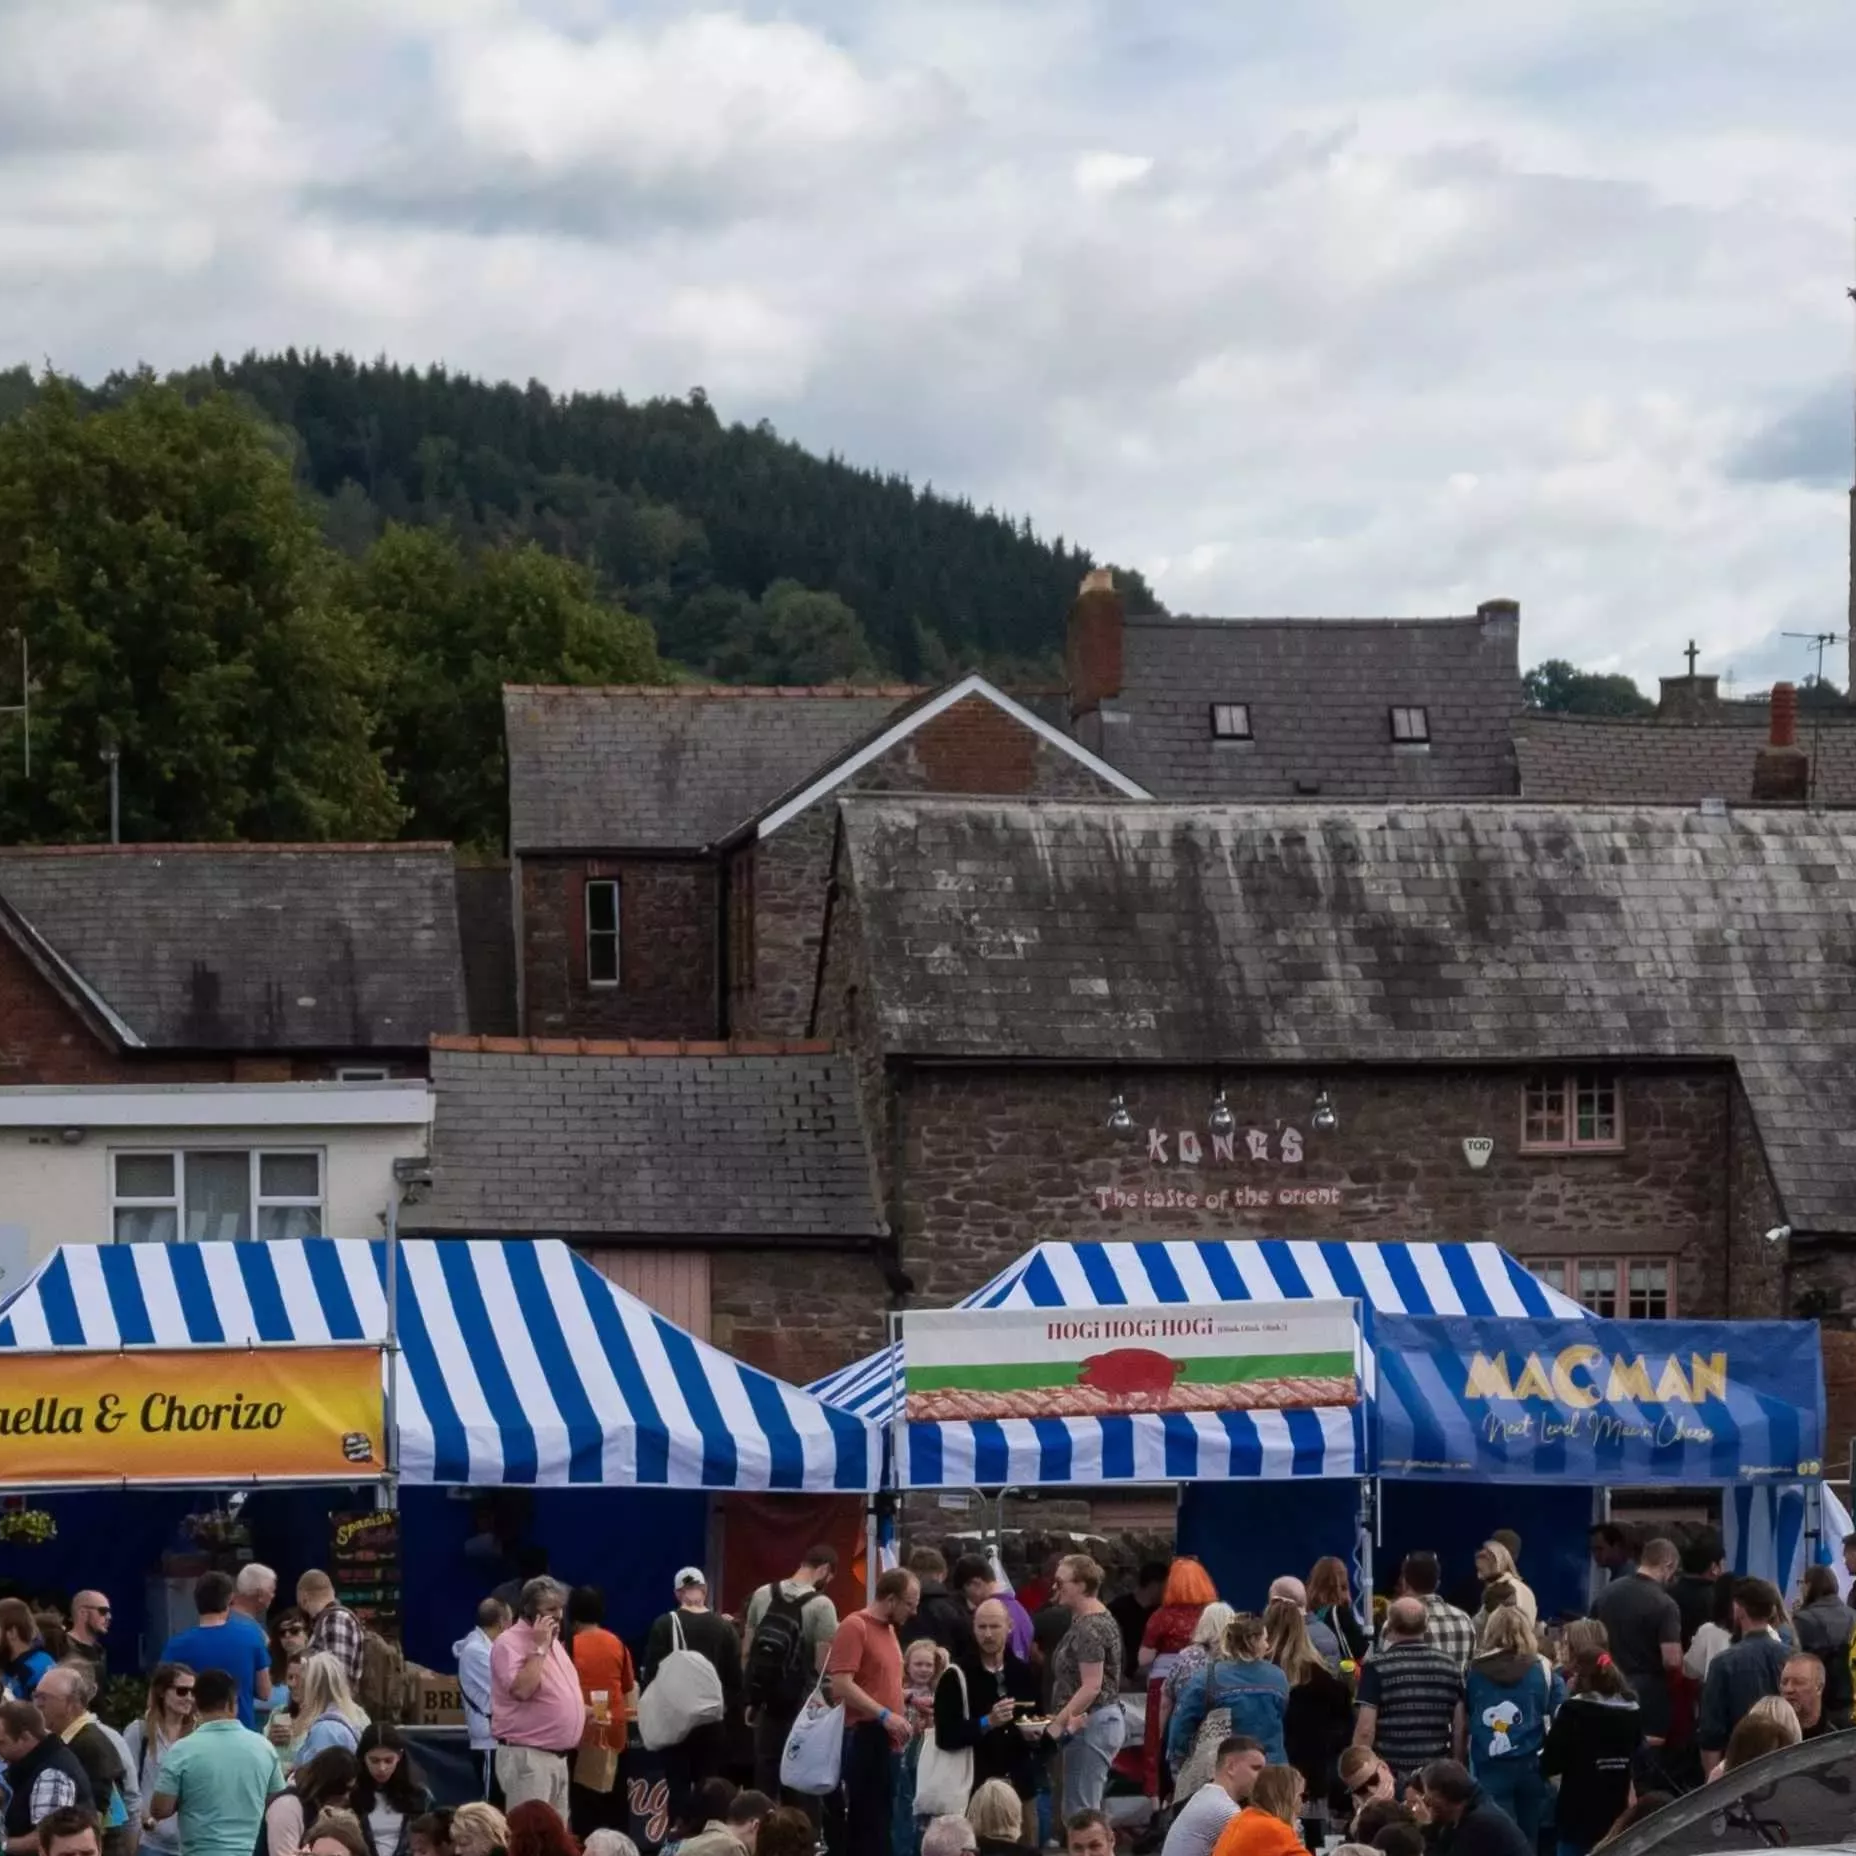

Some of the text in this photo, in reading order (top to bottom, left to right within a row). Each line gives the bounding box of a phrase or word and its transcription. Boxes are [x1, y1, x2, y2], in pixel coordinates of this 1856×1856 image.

[1096, 1185, 1341, 1210] The taste of the orient
[1465, 1344, 1727, 1409] MACMAN
[95, 1393, 127, 1432] &
[140, 1392, 287, 1433] Chorizo
